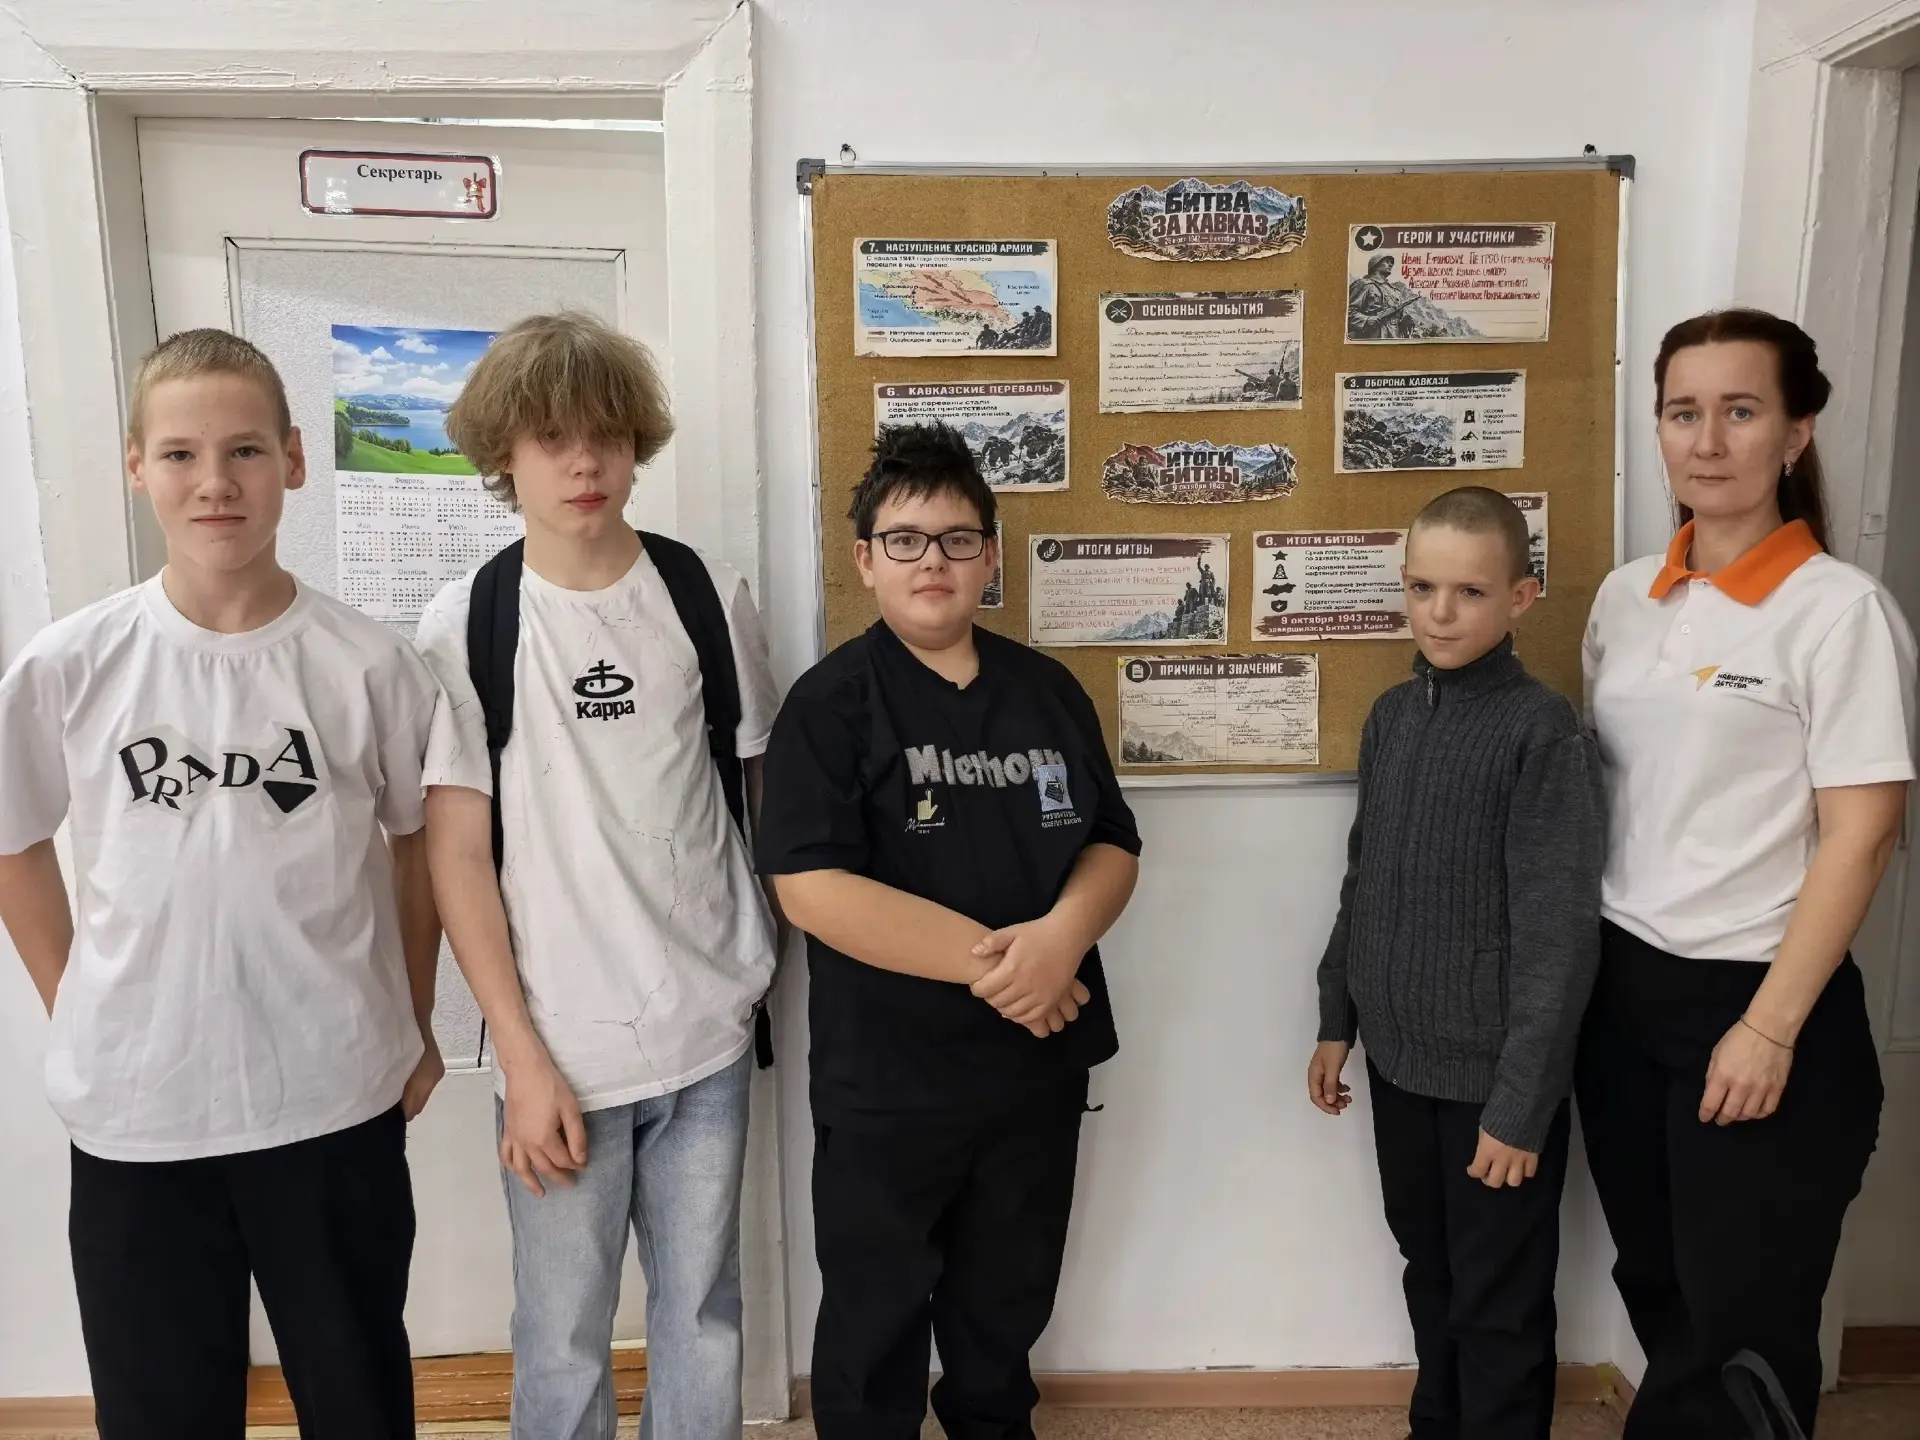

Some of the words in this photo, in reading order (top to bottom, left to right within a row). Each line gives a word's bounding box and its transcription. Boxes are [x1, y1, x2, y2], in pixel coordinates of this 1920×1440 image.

[357, 164, 443, 183] Секретарь
[1165, 191, 1251, 214] БИТВА
[1152, 214, 1181, 236] ЗА
[1186, 212, 1269, 236] КАВКАЗ
[1397, 231, 1432, 244] ГЕРОИ
[1437, 231, 1444, 244] И
[1449, 230, 1515, 244] УЧАСТНИКИ
[868, 243, 879, 253] 7.
[886, 243, 951, 253] НАСТУПЛЕНИЕ
[955, 242, 997, 253] КРАСНОЙ
[1000, 243, 1033, 253] АРМИИ
[1142, 304, 1205, 317] ОСНОВНЫЕ
[1209, 302, 1264, 316] СОБЫТИЯ
[1365, 378, 1406, 388] ОБОРОНА
[1409, 376, 1450, 387] КАВКАЗА
[908, 385, 986, 396] КАВКАЗСКИЕ
[989, 384, 1053, 394] ПЕРЕВАЛЫ
[1166, 451, 1234, 468] ИТОГИ
[1159, 467, 1240, 486] БИТВЫ
[1265, 537, 1277, 546] 8.
[1286, 536, 1322, 545] ИТОГИ
[1325, 535, 1365, 544] БИТВЫ
[1077, 543, 1111, 556] ИТОГИ
[1115, 543, 1153, 556] БИТВЫ
[1281, 616, 1288, 624] 9
[1290, 615, 1334, 625] октября
[1338, 613, 1362, 622] 1943
[1365, 615, 1389, 623] года
[1268, 626, 1324, 634] завершилась
[1160, 663, 1213, 676] ПРИЧИНЫ
[1217, 663, 1224, 675] И
[1228, 662, 1284, 675] ЗНАЧЕНИЕ
[575, 699, 636, 721] Kappa
[118, 727, 320, 811] PRADA
